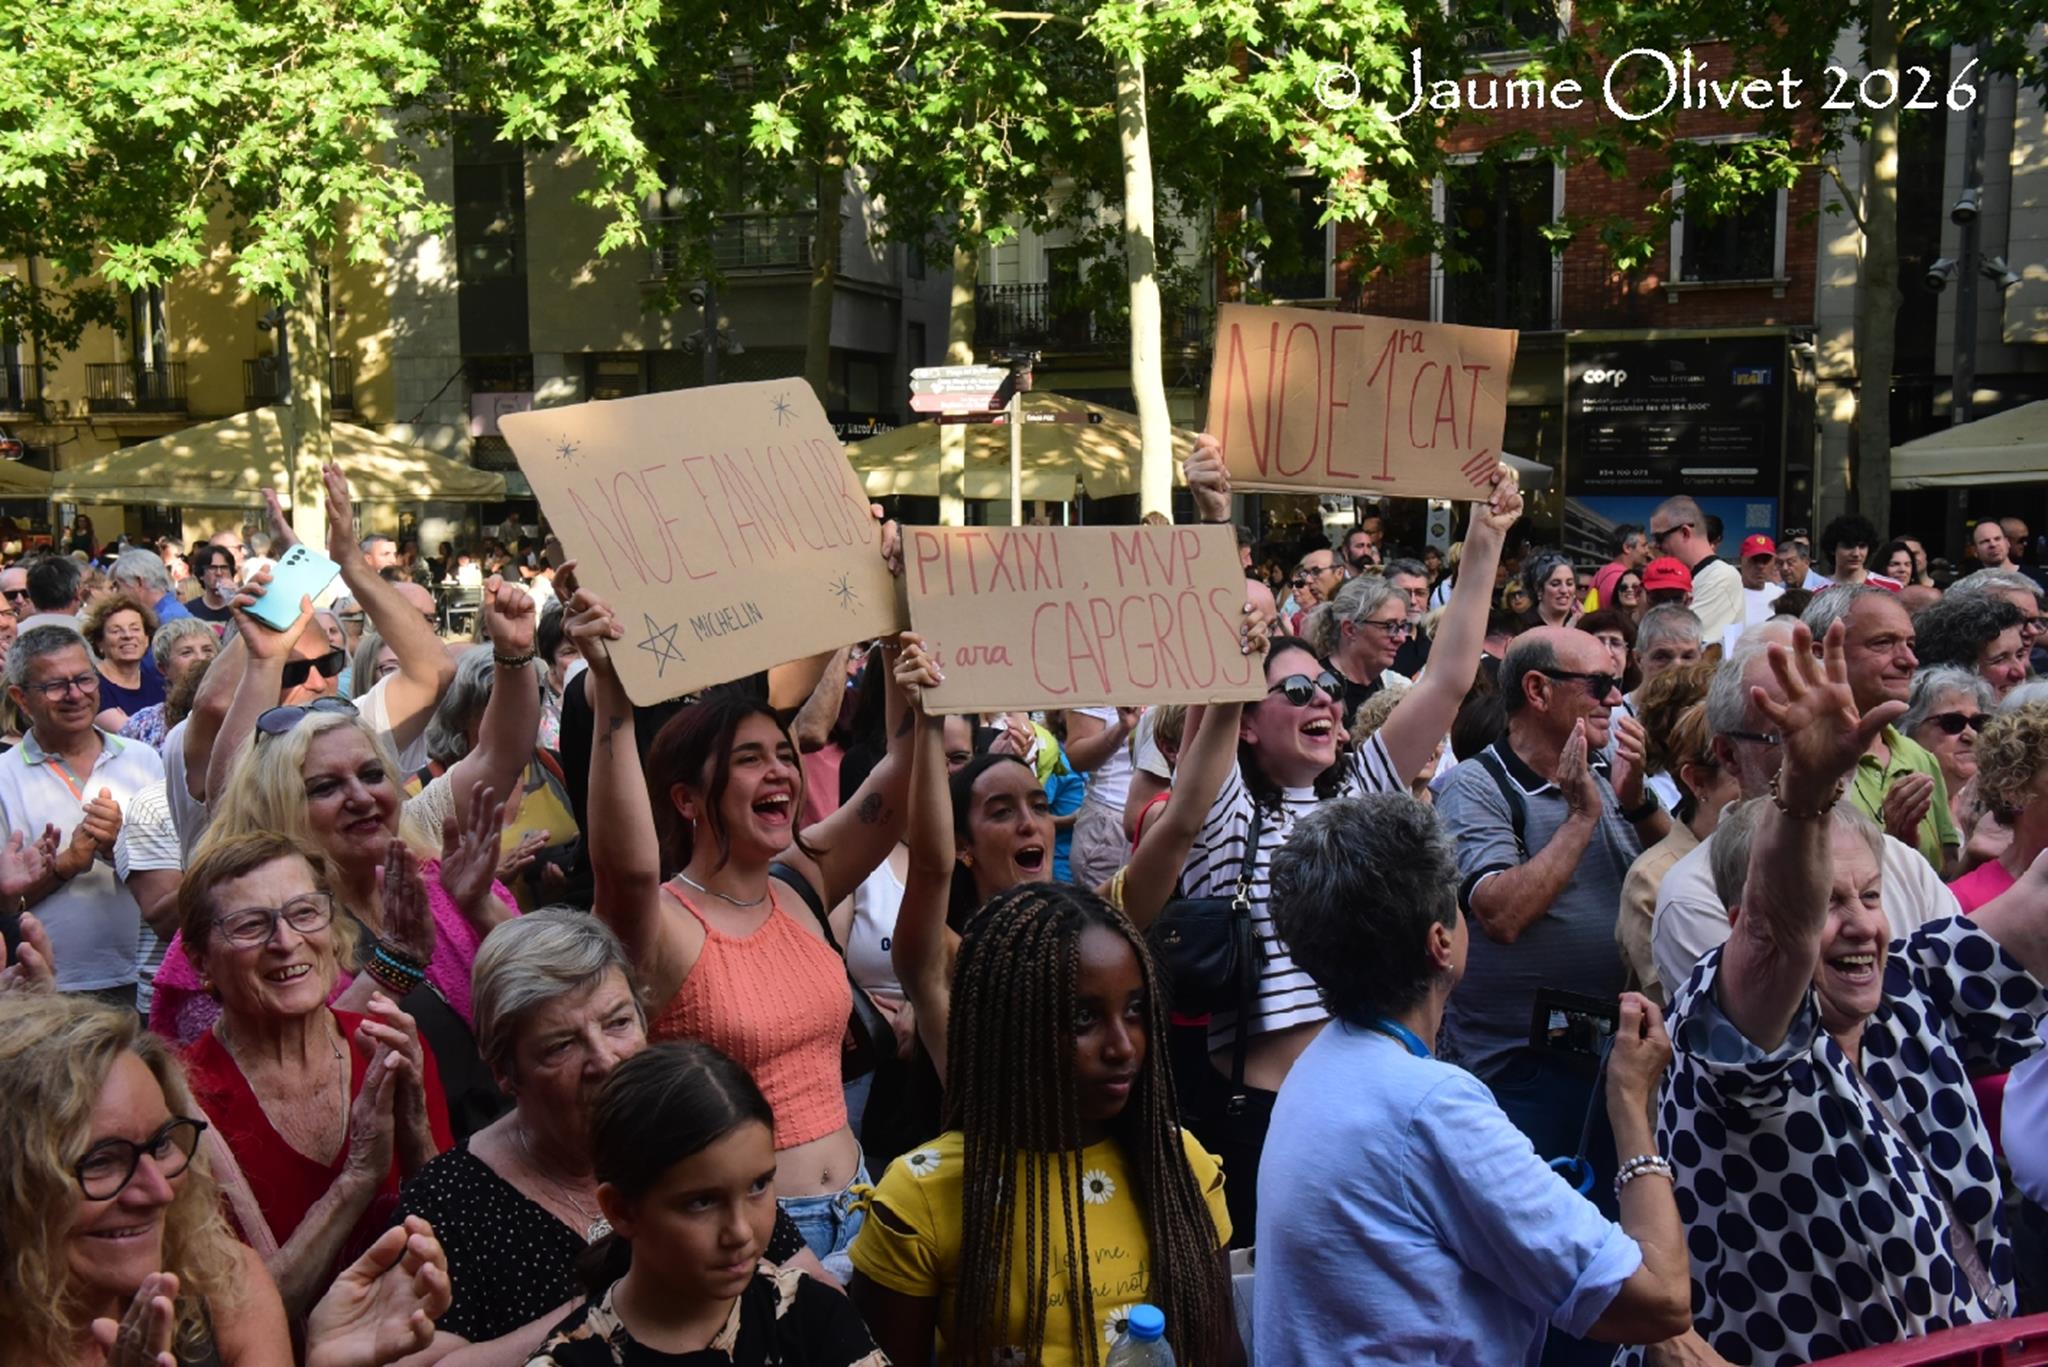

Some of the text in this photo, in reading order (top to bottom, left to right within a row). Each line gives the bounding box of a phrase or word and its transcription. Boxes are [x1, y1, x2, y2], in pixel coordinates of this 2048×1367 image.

[1221, 321, 1365, 478] NOE
[1408, 360, 1491, 450] CAT
[1582, 369, 1628, 388] corp
[567, 465, 718, 591] NOE
[1109, 530, 1201, 588] MVP
[934, 584, 1253, 696] i ara CAPGRÓS
[1116, 1260, 1152, 1297] not
